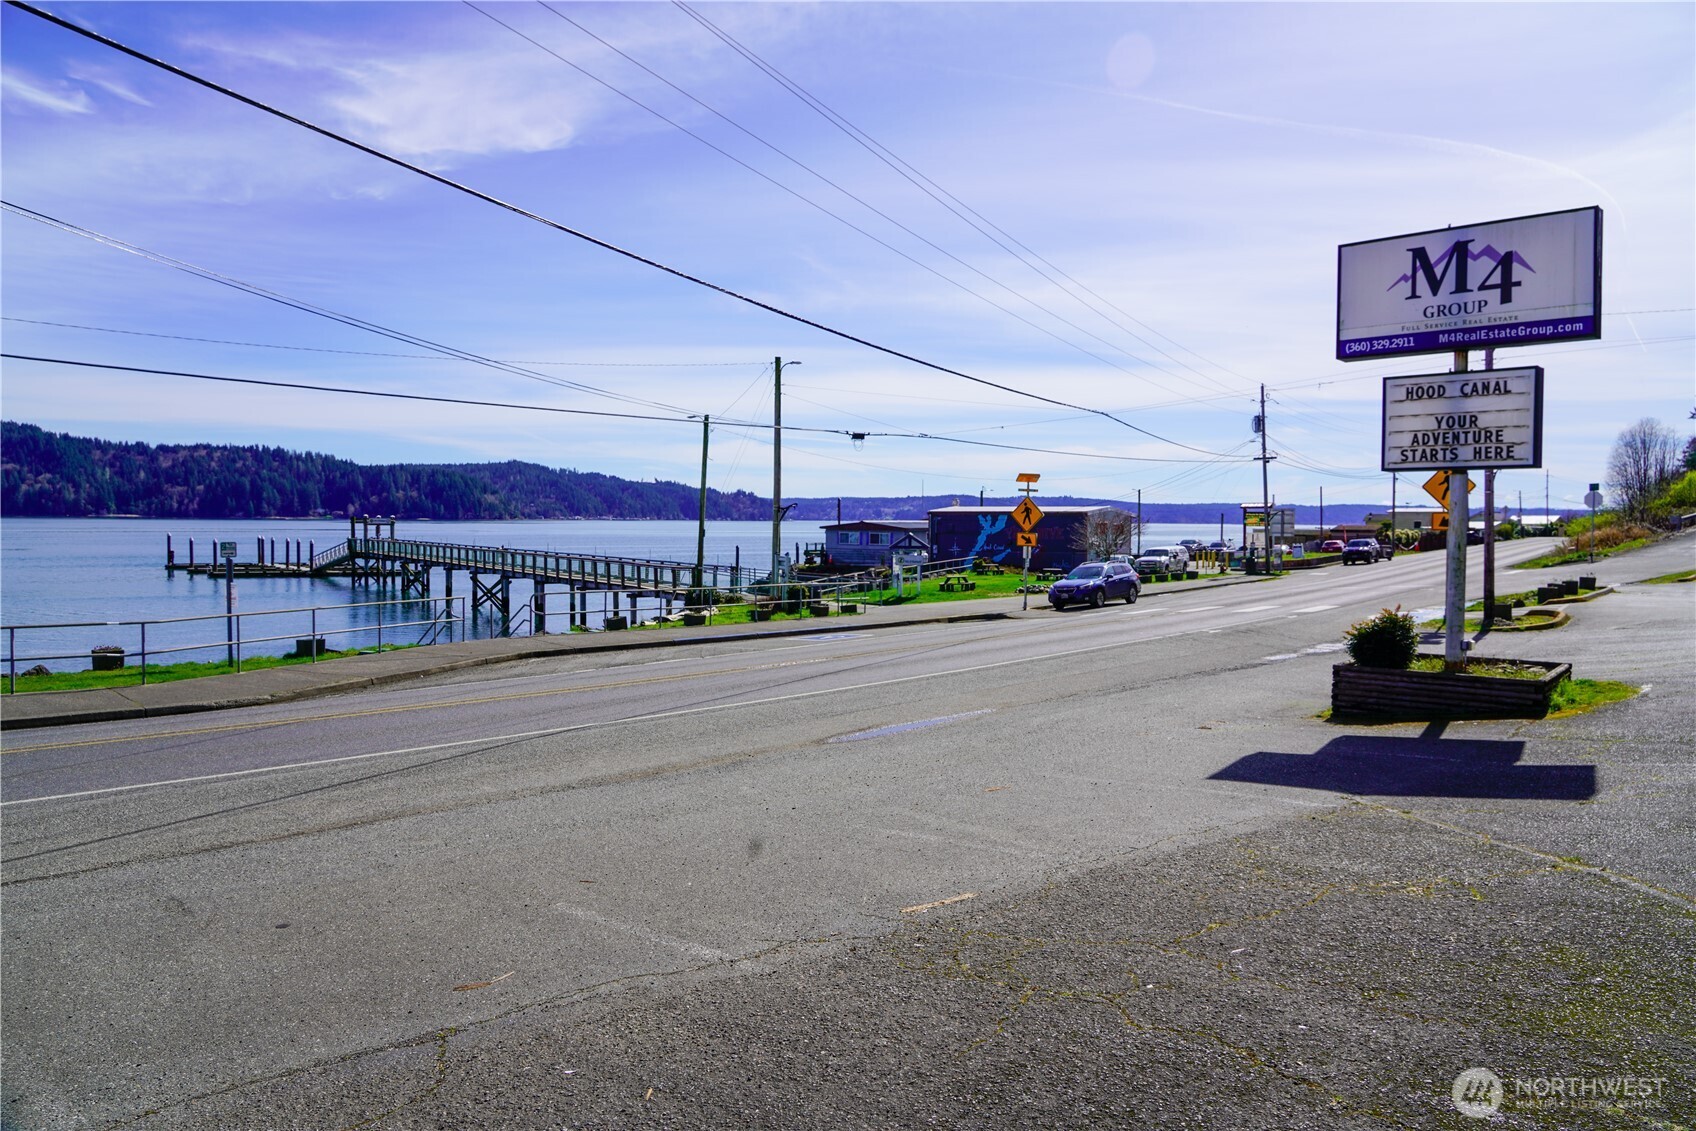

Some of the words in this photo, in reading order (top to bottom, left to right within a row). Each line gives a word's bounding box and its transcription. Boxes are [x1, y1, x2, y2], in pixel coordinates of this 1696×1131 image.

[1405, 238, 1522, 305] M4
[1423, 300, 1488, 319] GROUP
[1401, 323, 1420, 332] FULL
[1424, 320, 1458, 331] SERVICE
[1462, 317, 1483, 326] REAL
[1487, 314, 1519, 324] ESTATE
[1438, 321, 1583, 344] M4RealEstateGroup.com
[1345, 341, 1370, 354] (360)
[1372, 337, 1415, 350] 329.2911
[1406, 384, 1446, 400] HOOD
[1460, 380, 1512, 396] CANAL
[1435, 415, 1478, 429] YOUR
[1411, 429, 1504, 446] ADVENTURE
[1400, 447, 1458, 462] STARTS
[1473, 445, 1514, 459] HERE
